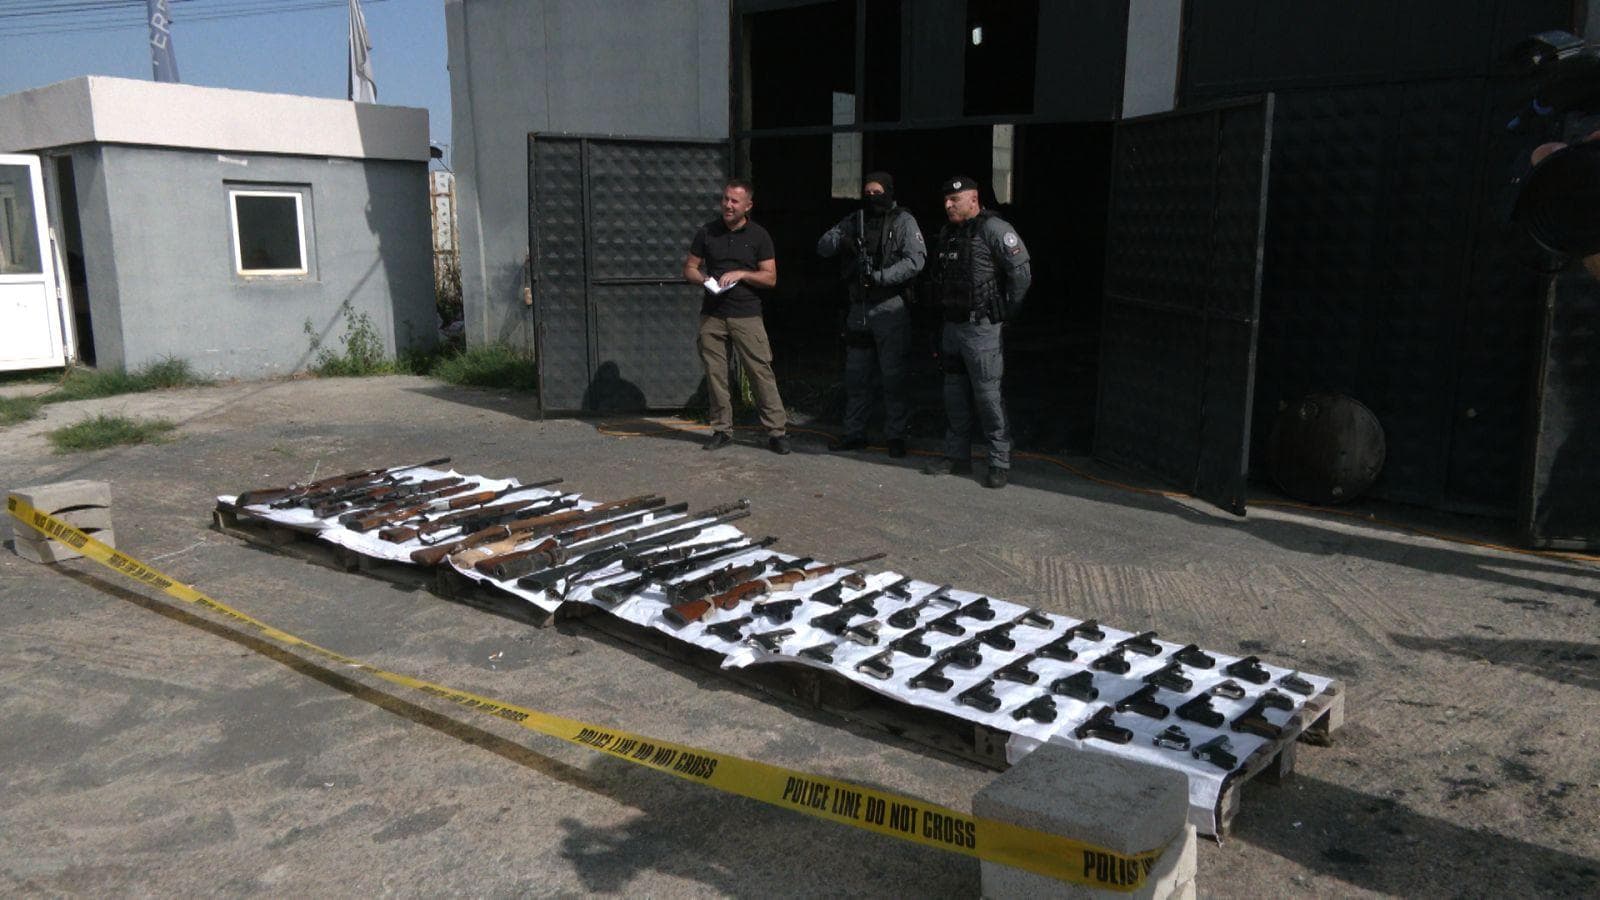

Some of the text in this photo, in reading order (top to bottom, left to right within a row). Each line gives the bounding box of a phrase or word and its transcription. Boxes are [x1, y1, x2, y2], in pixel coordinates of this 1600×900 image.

[573, 728, 718, 779] POLICE LINE DO NOT CROSS
[783, 776, 976, 850] POLICE LINE DO NOT CROSS
